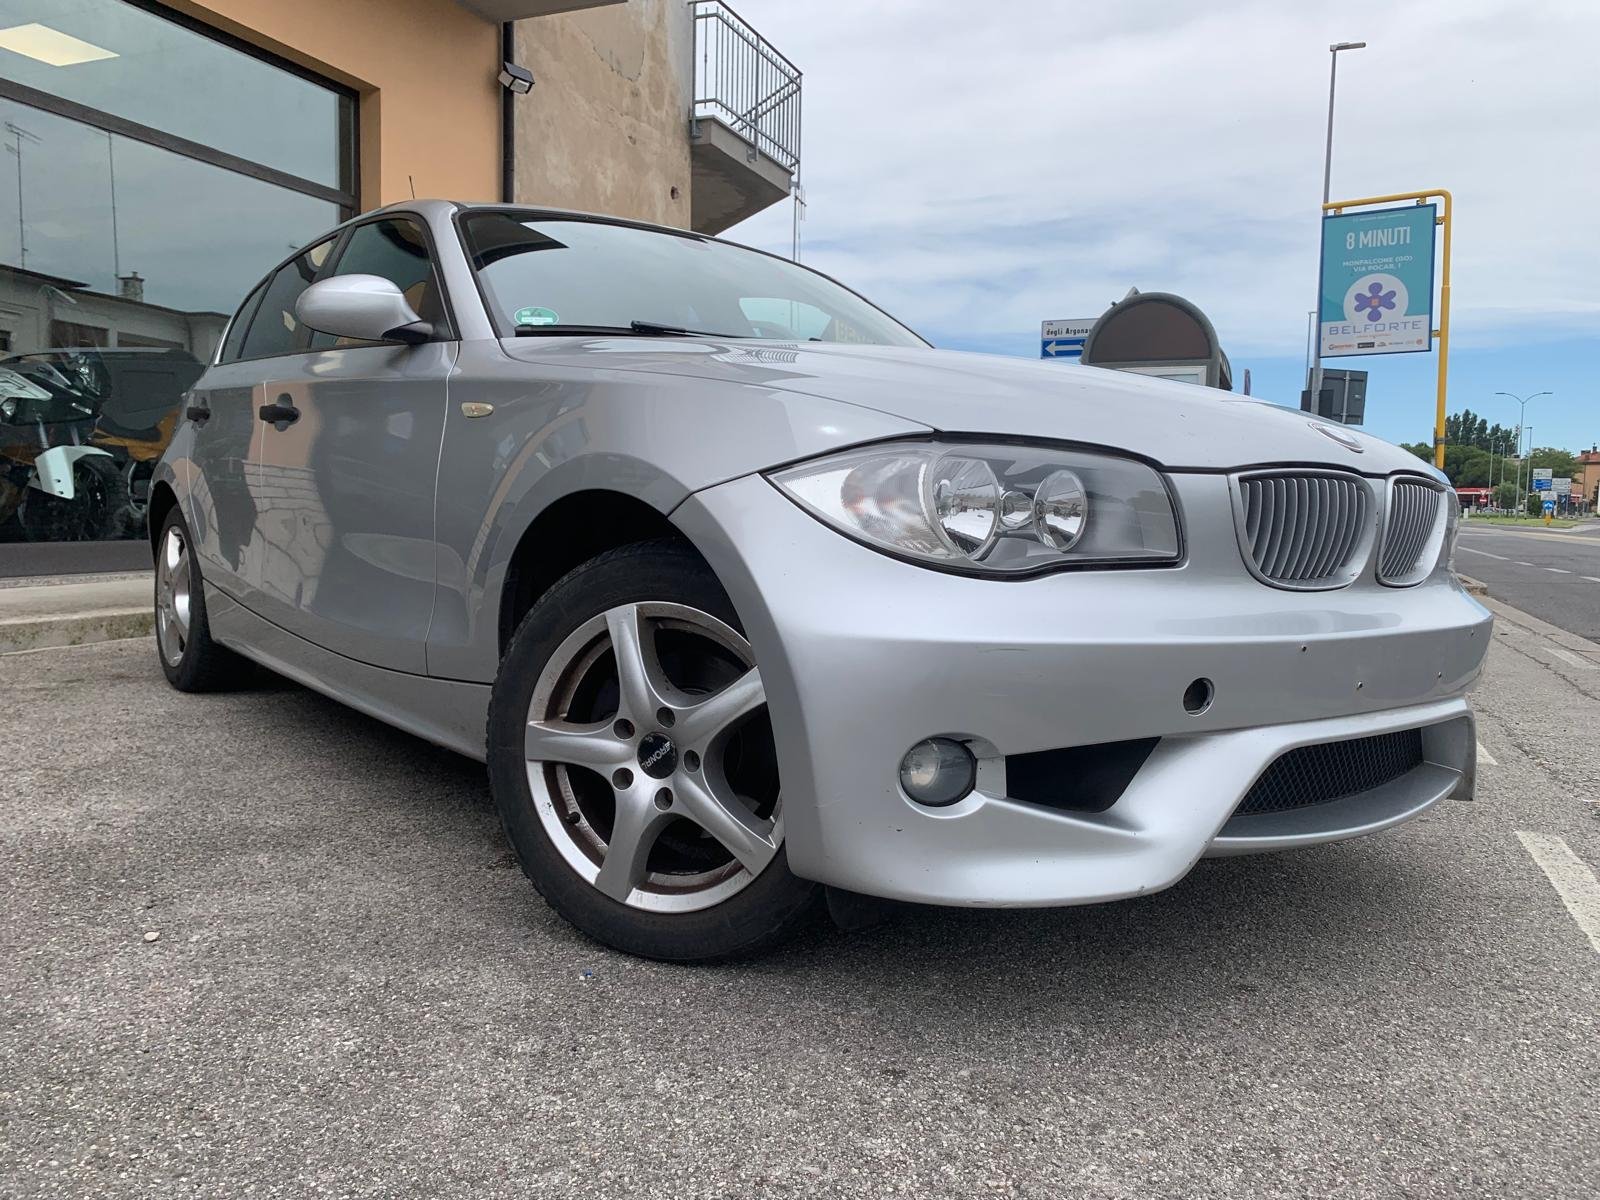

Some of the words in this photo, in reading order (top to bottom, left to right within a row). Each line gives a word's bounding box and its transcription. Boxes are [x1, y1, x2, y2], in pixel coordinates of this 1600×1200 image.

[1346, 232, 1355, 250] 8
[1359, 226, 1411, 249] MINUTI
[1343, 257, 1393, 267] MONFALCONE
[1046, 328, 1062, 336] degli
[1329, 320, 1422, 336] BELFORTE
